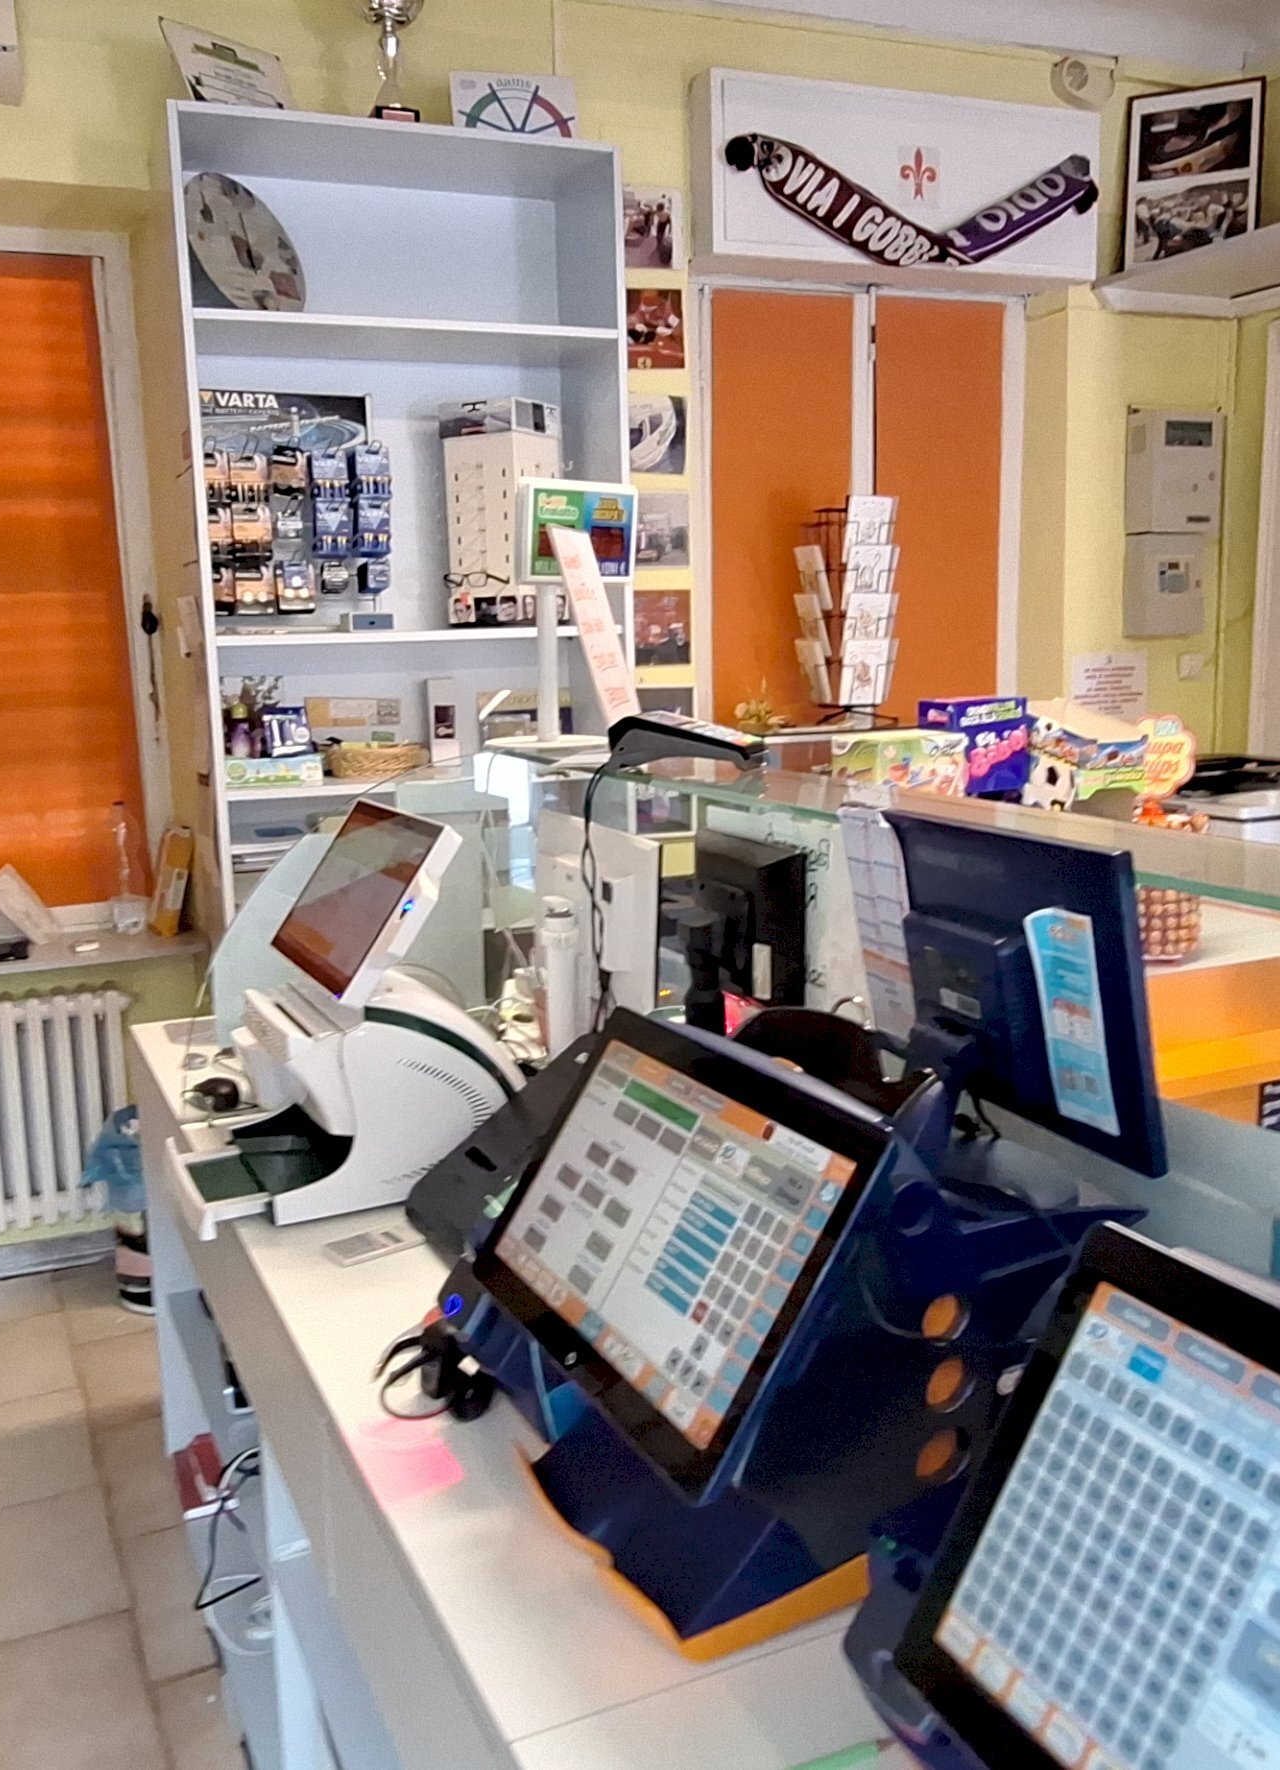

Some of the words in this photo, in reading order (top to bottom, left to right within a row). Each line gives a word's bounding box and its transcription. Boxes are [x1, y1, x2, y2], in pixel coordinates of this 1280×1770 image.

[783, 155, 840, 217] VIA
[832, 193, 861, 229] I
[215, 392, 279, 409] VARTA
